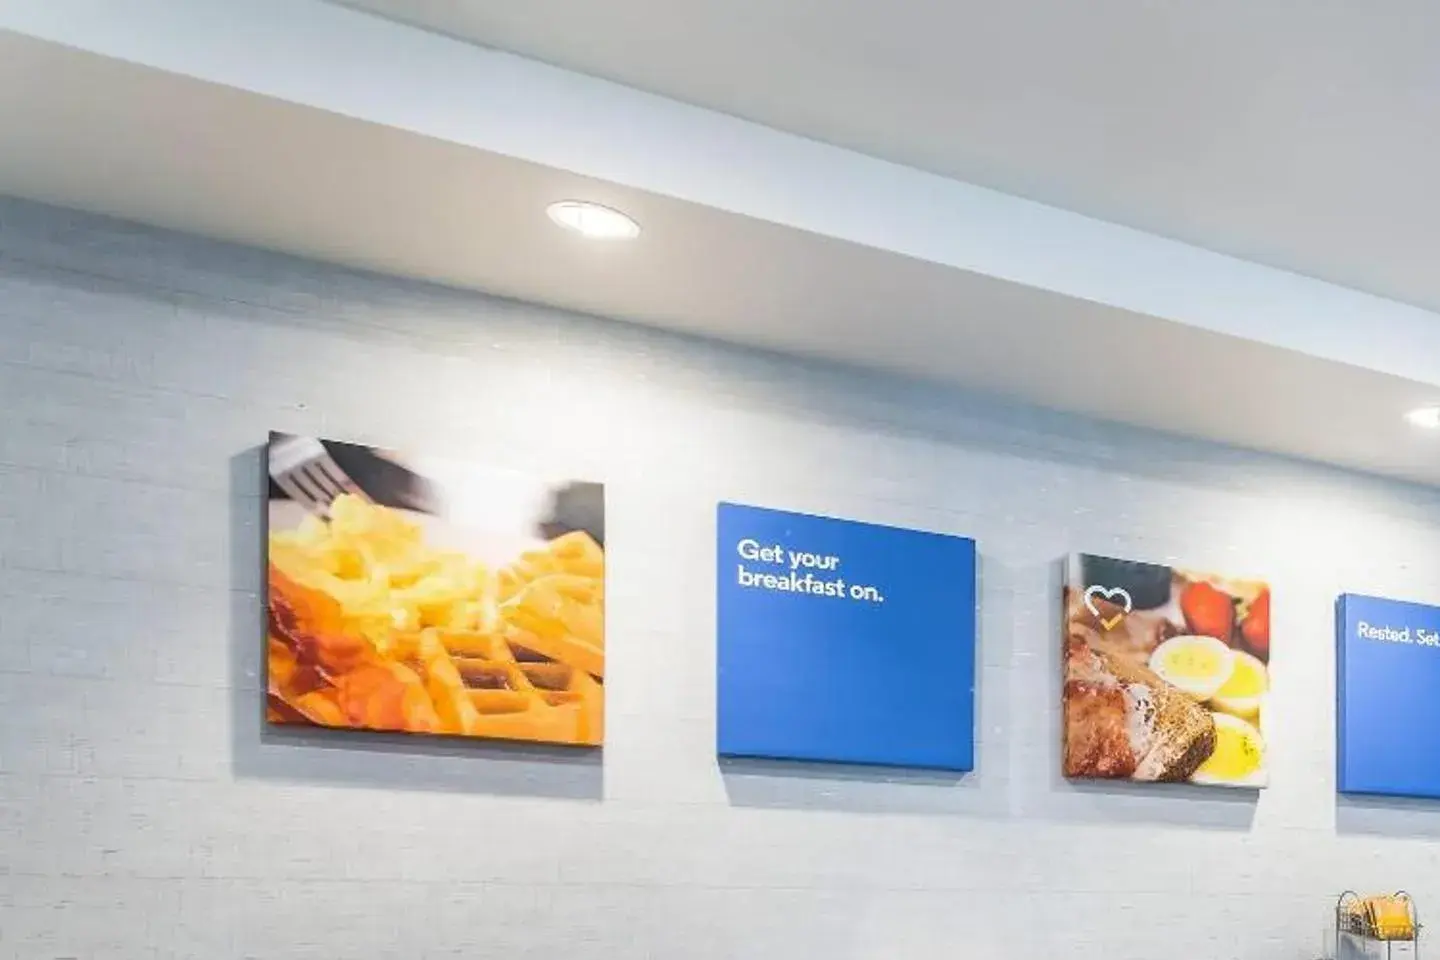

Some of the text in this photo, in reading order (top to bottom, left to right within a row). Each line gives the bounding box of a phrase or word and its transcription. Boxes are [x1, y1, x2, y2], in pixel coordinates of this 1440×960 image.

[737, 538, 839, 571] Get your
[737, 564, 884, 602] breakfast on.
[1358, 621, 1414, 644] Rested.
